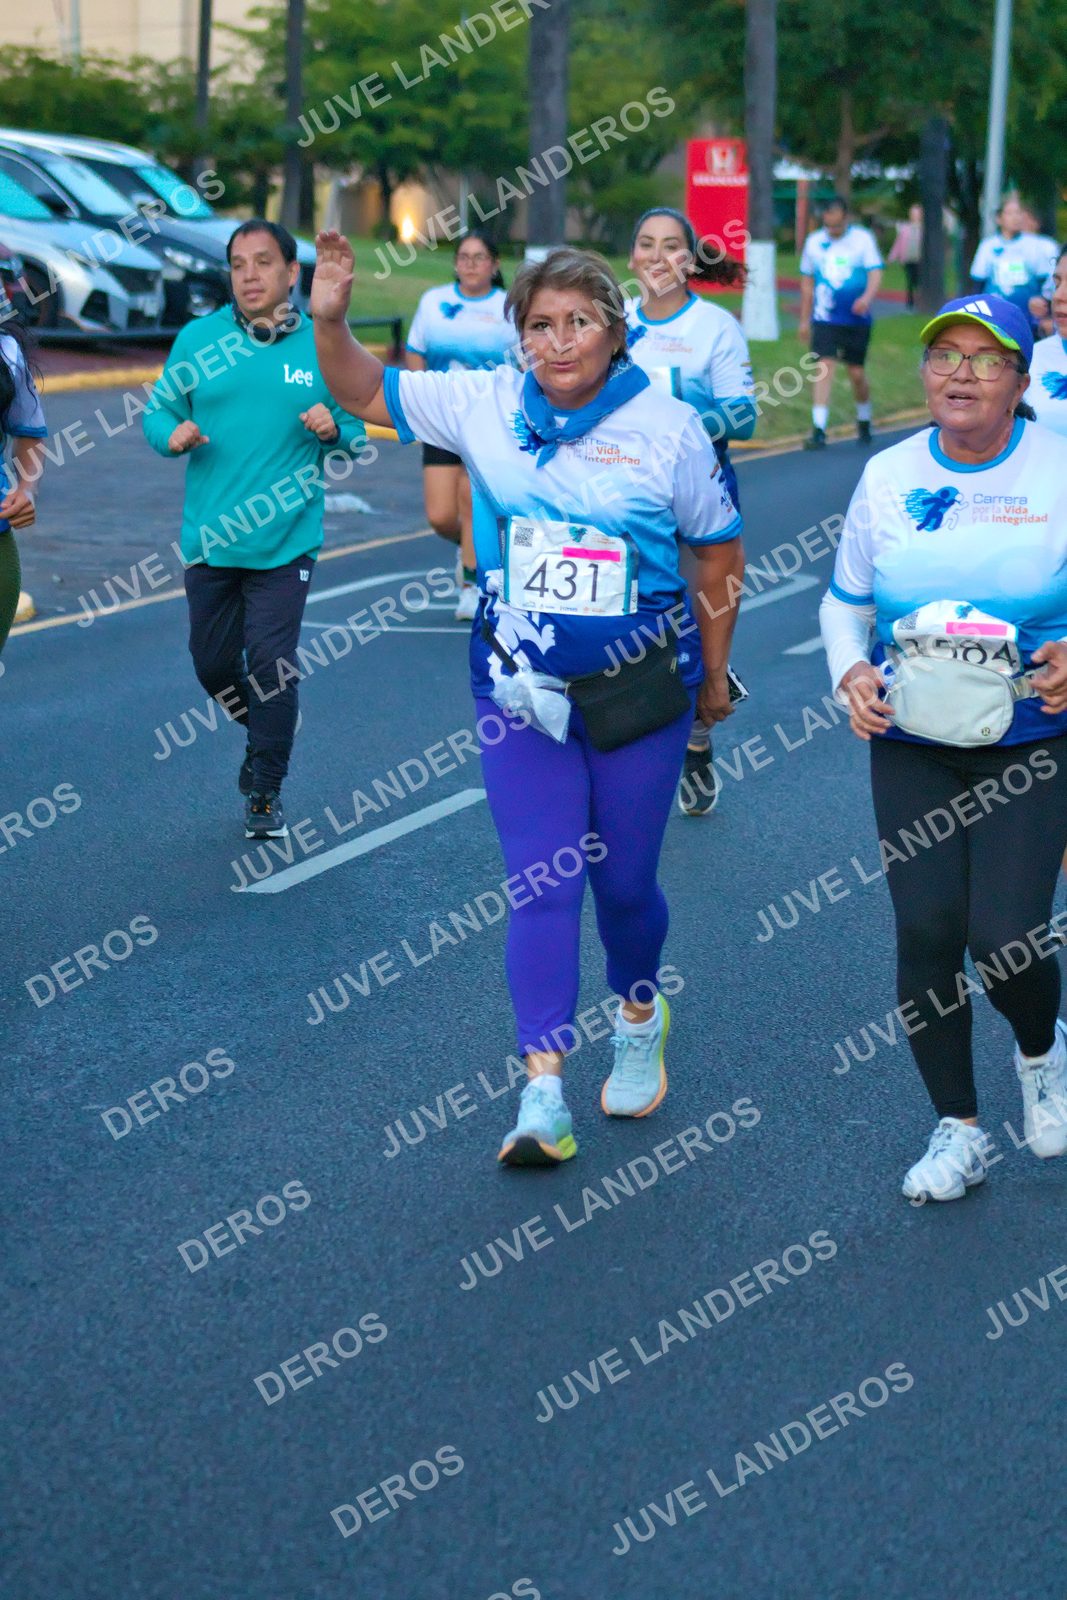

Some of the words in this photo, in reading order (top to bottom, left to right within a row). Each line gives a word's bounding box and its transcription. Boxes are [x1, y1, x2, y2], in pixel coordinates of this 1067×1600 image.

[283, 363, 314, 388] Lee
[596, 445, 621, 455] Vida
[973, 493, 1028, 505] Carrera
[1003, 505, 1029, 515] Vida
[991, 513, 1048, 526] Integridad
[523, 558, 599, 602] 431
